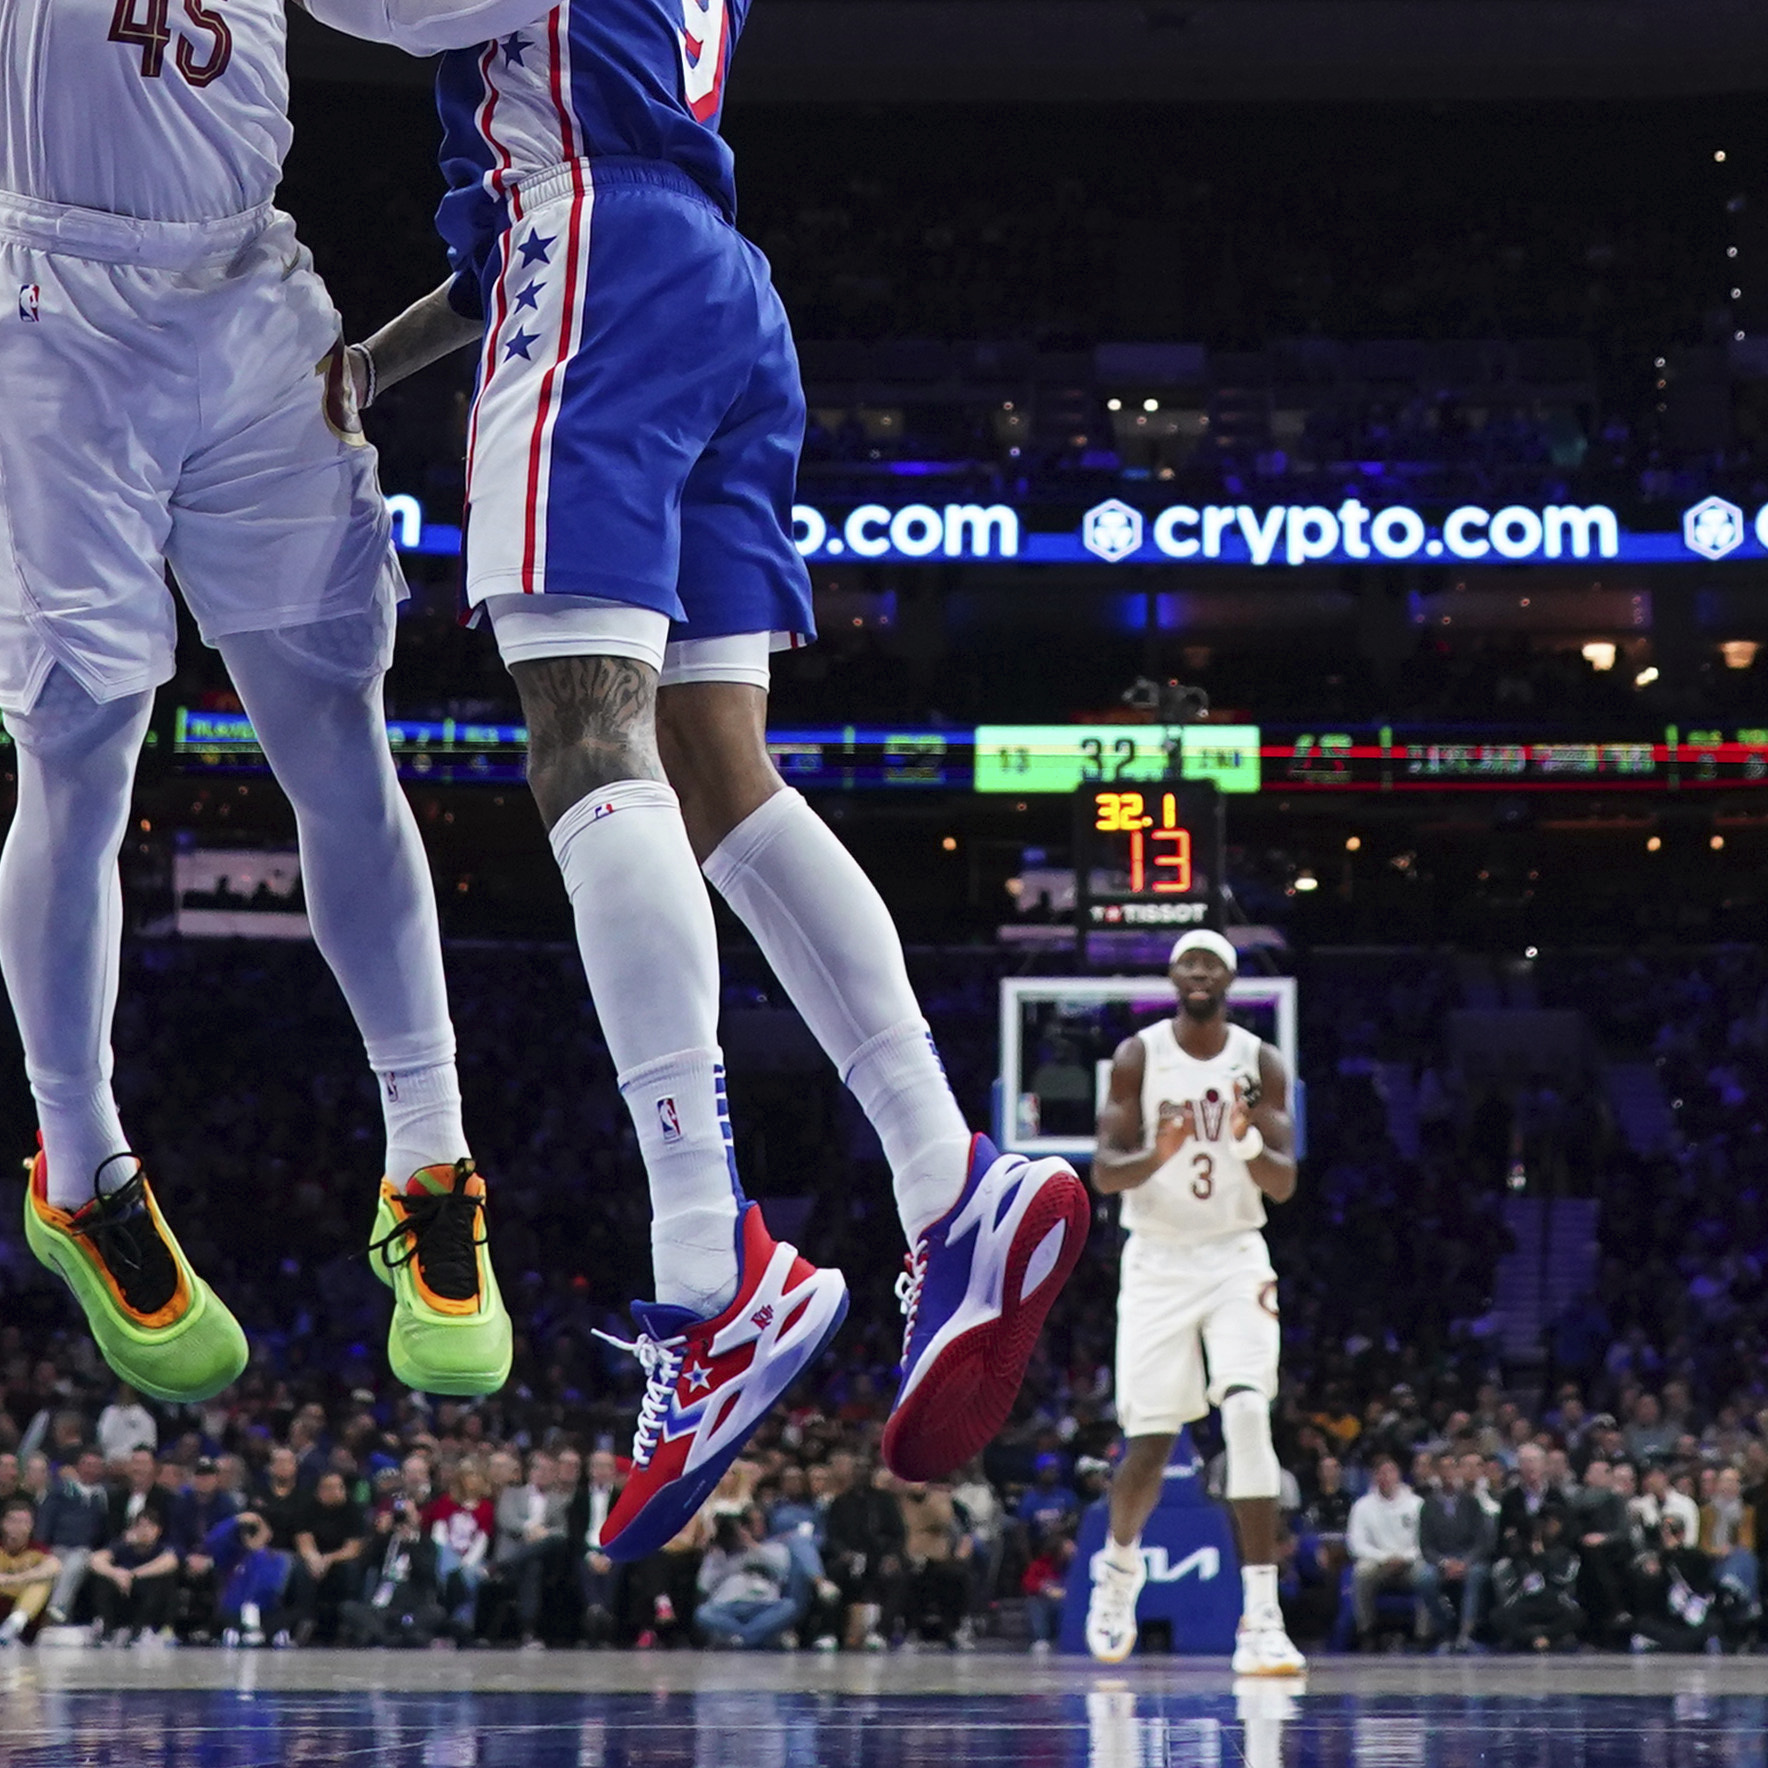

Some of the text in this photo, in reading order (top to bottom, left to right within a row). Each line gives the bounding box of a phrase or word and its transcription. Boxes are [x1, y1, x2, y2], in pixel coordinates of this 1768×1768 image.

[1152, 498, 1621, 565] crypto.com
[1094, 792, 1177, 831] 32.1
[1130, 829, 1191, 893] 13
[1191, 1153, 1217, 1200] 3
